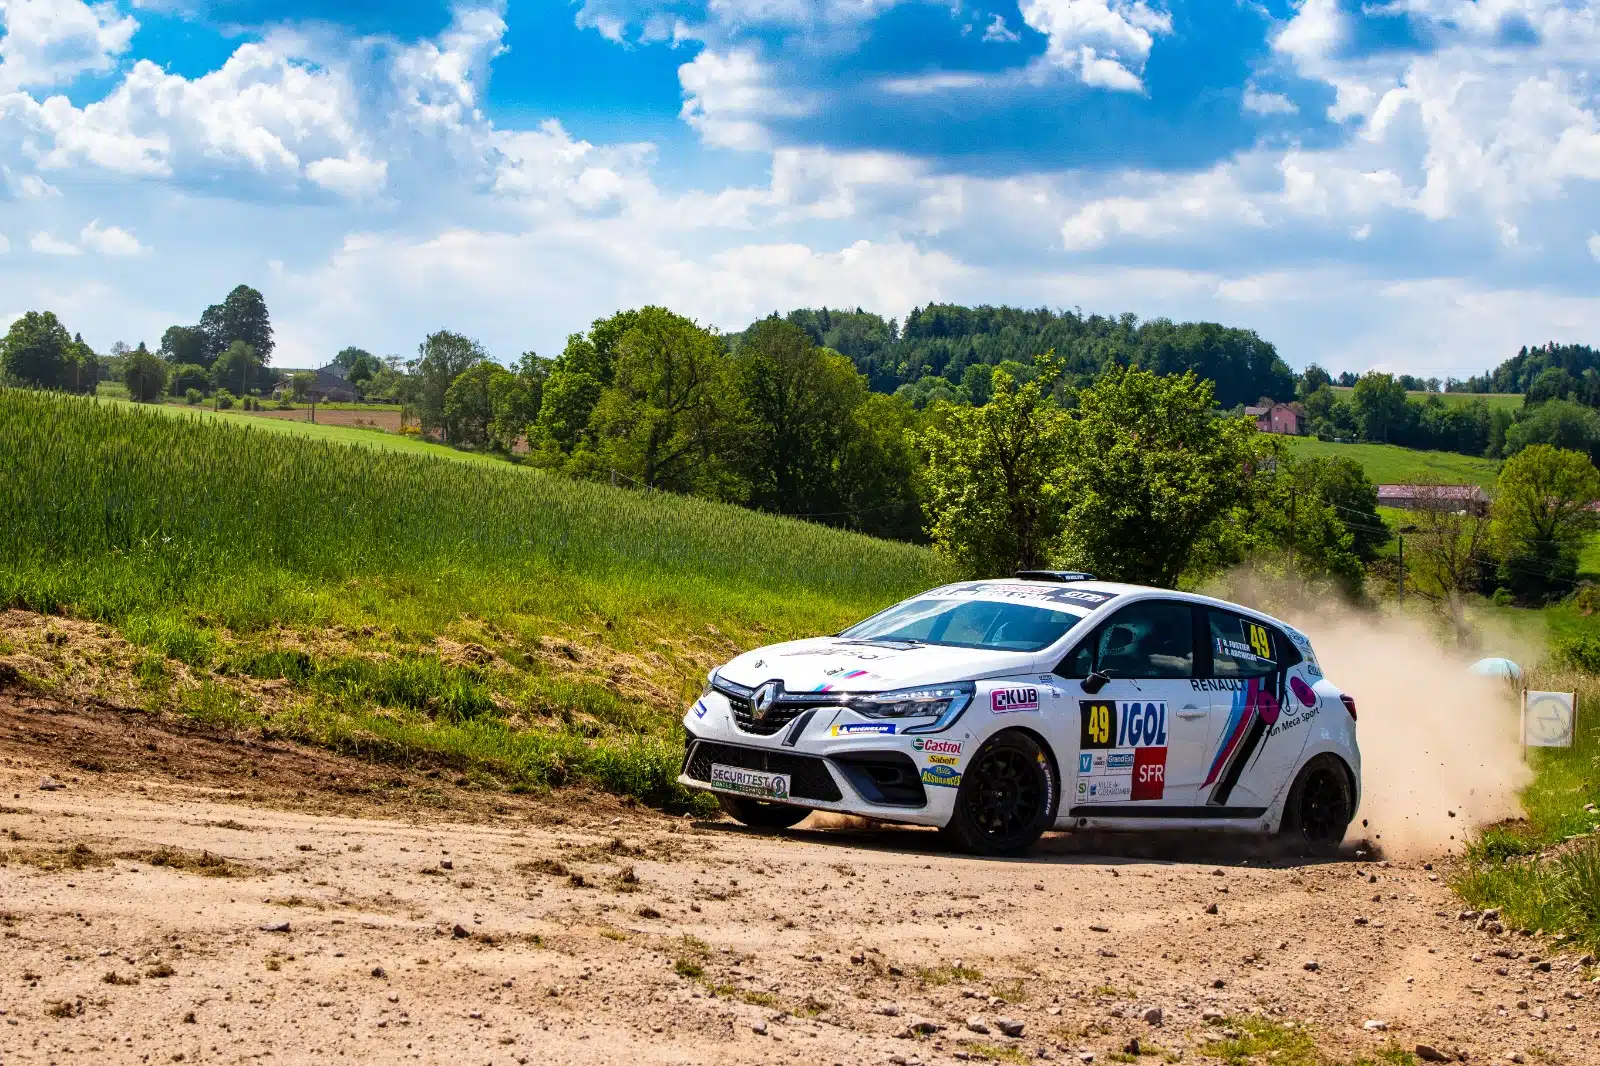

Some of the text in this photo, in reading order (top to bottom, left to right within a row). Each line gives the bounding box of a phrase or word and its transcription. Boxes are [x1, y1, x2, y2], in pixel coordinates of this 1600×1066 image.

[1250, 624, 1270, 659] 49
[1190, 679, 1247, 692] RENAULT
[1088, 705, 1109, 743] 49
[1118, 702, 1167, 746] IGOL
[1281, 716, 1301, 732] Meca
[1301, 706, 1320, 723] Sport
[849, 725, 889, 733] MICHELIN
[924, 739, 962, 754] Castrol
[713, 768, 769, 787] SECURITEST
[921, 770, 961, 786] ASSURANCES
[1139, 764, 1164, 783] SFR
[1043, 769, 1053, 816] MICHELIN
